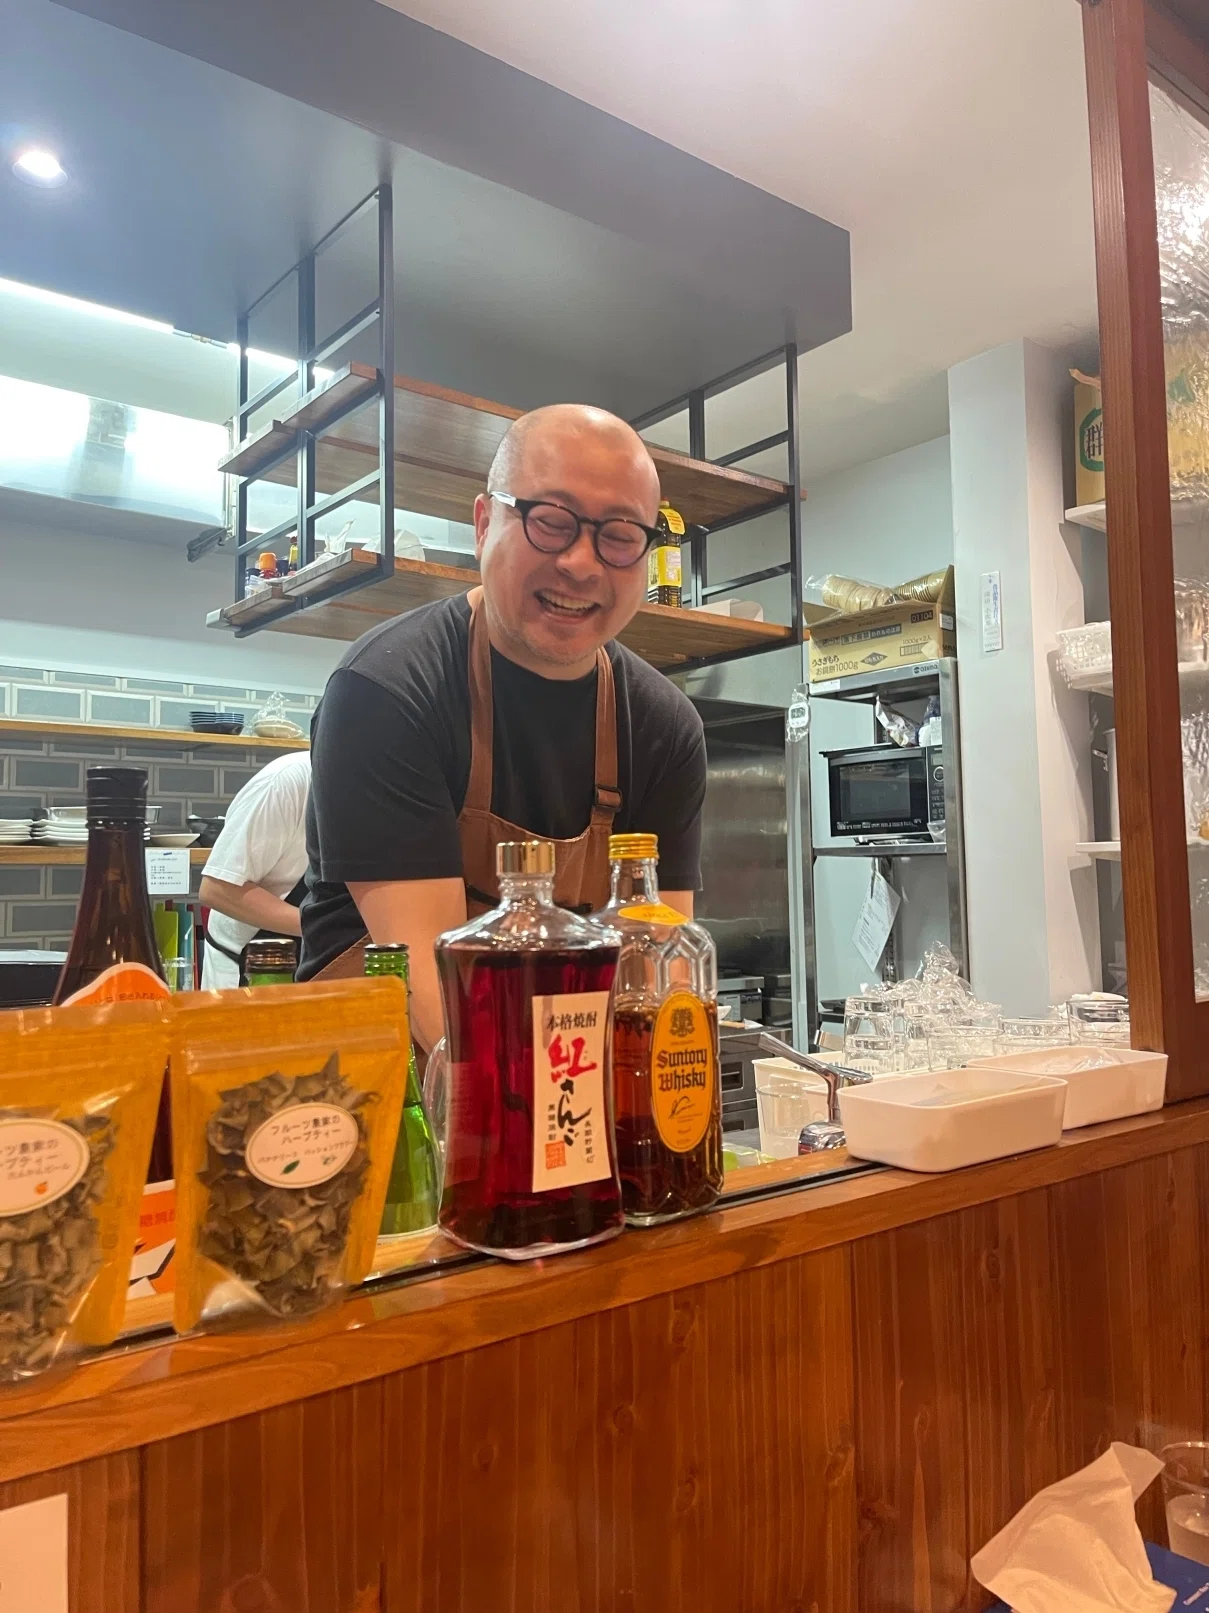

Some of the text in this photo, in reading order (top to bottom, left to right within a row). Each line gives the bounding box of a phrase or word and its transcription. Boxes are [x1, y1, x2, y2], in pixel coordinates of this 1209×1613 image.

[911, 610, 933, 622] 01104
[812, 655, 840, 666] うさぎもち
[547, 1011, 598, 1032] 本格焼酎
[656, 1048, 708, 1069] Suntory
[658, 1067, 706, 1093] Whisky
[271, 1114, 341, 1135] フルーツ農家の
